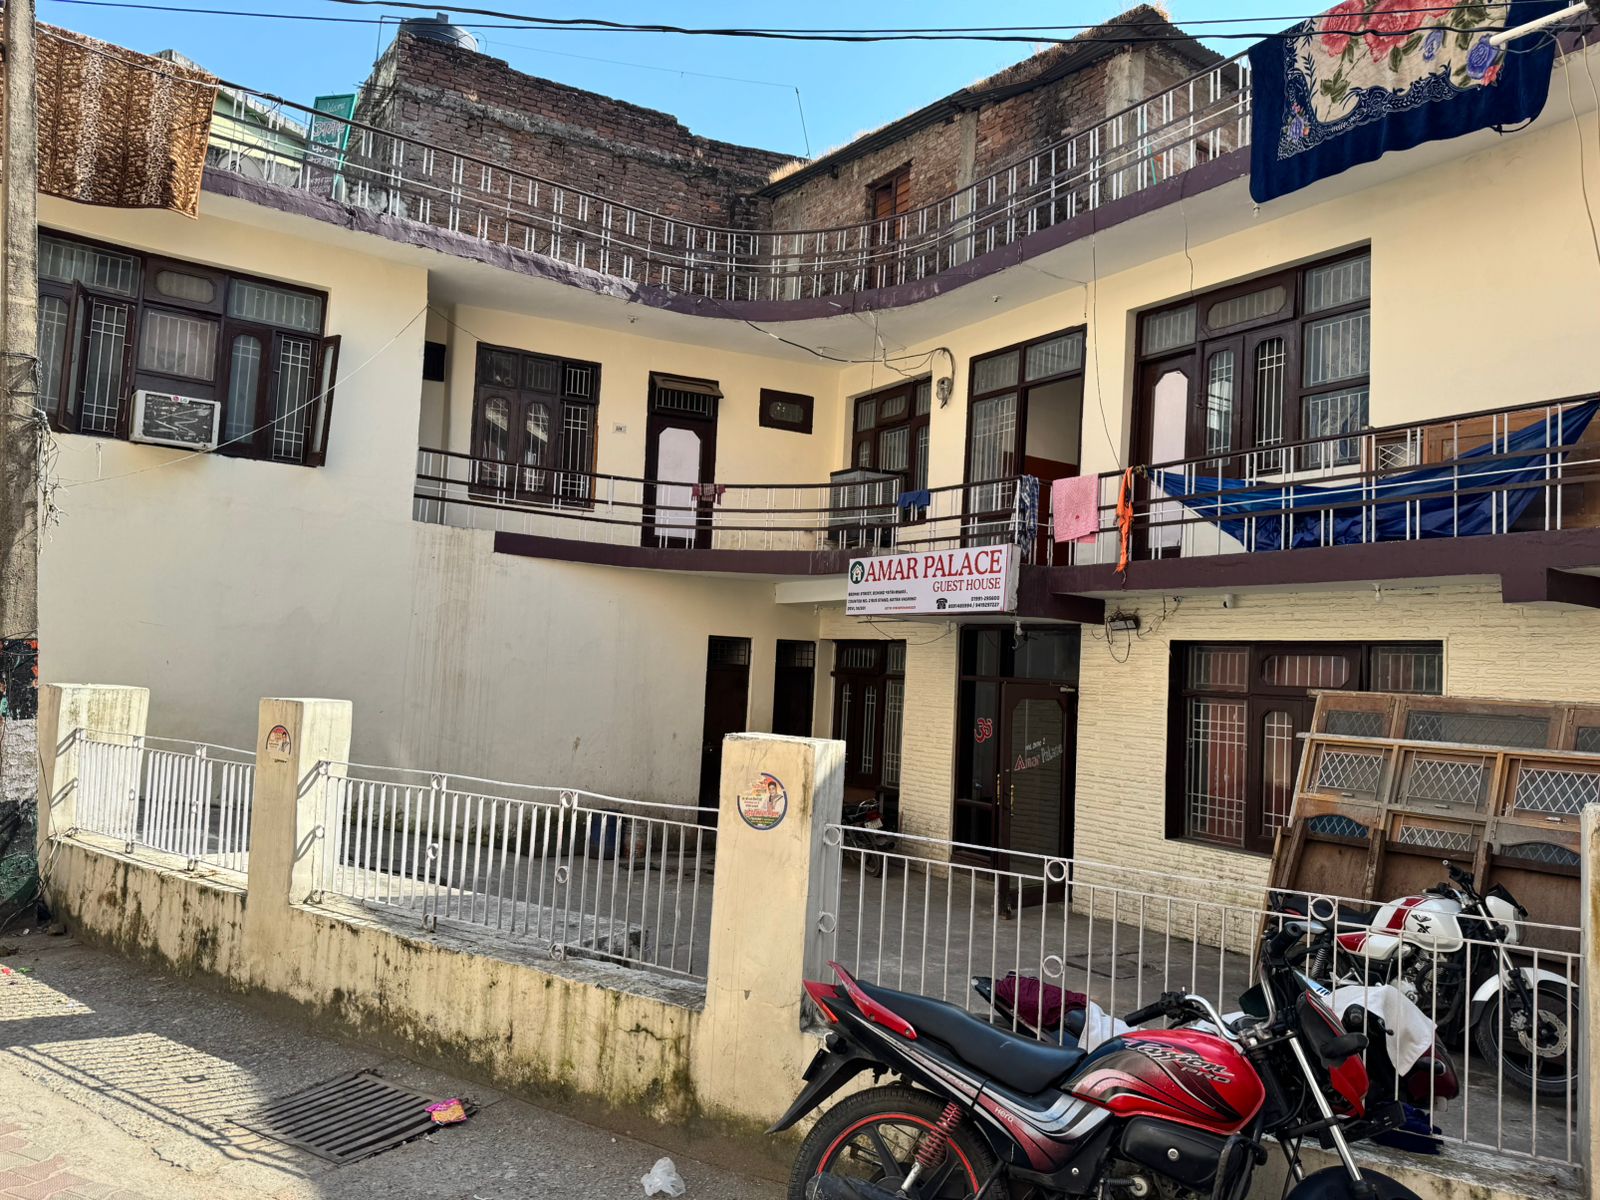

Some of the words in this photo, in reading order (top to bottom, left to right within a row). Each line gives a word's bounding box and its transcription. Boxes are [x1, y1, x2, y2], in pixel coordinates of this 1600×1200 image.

[865, 557, 918, 582] AMAR
[923, 549, 1002, 578] PALACE
[932, 580, 964, 592] GUEST
[966, 578, 1000, 590] HOUSE
